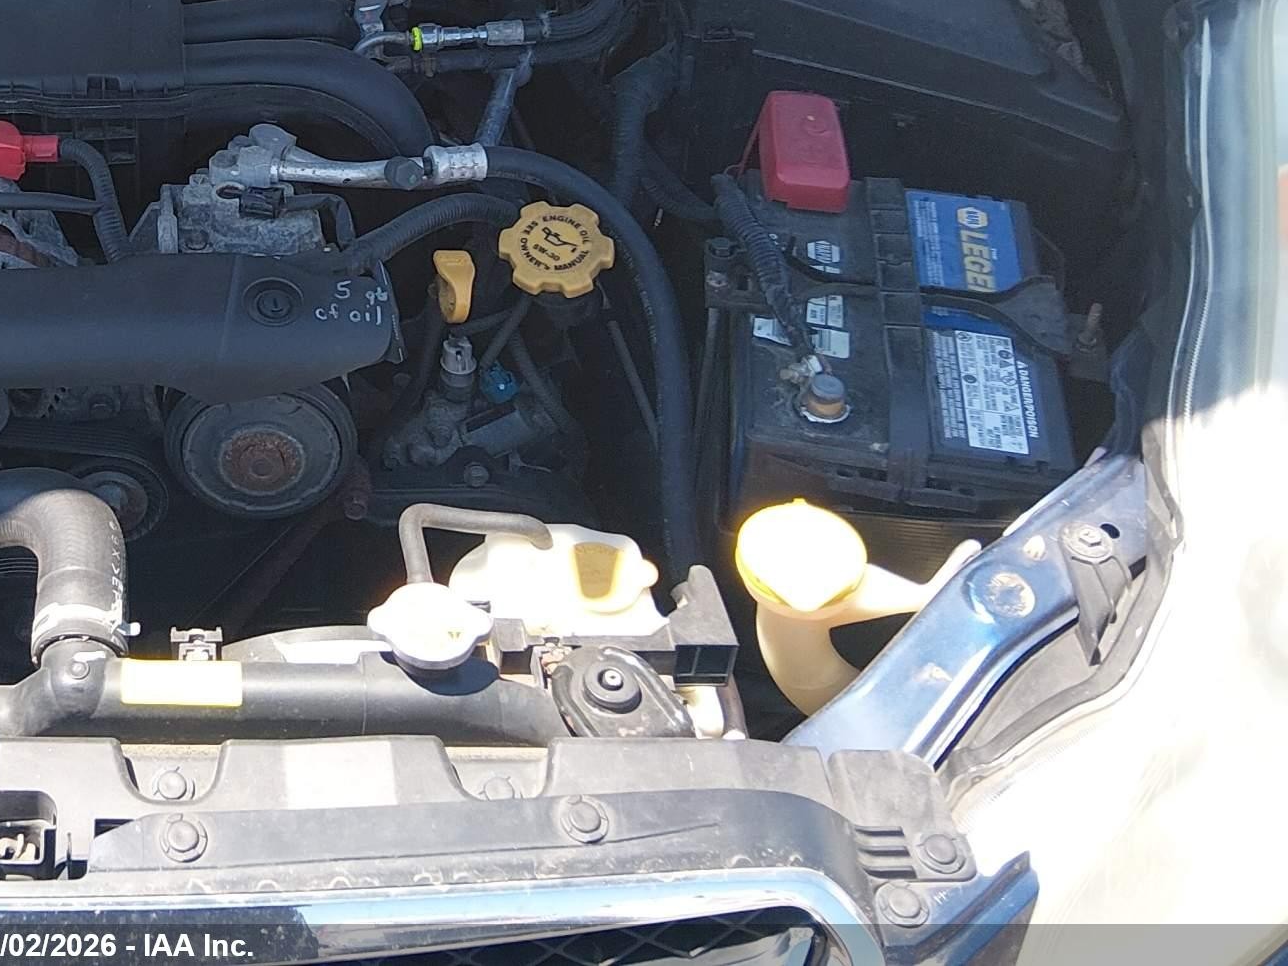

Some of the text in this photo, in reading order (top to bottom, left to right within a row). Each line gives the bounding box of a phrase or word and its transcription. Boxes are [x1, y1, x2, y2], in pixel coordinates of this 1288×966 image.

[541, 214, 592, 245] ENGINE OIL
[522, 220, 539, 236] SEE
[553, 249, 590, 271] MANUAL
[532, 243, 562, 262] 5W-30
[349, 303, 383, 325] oil
